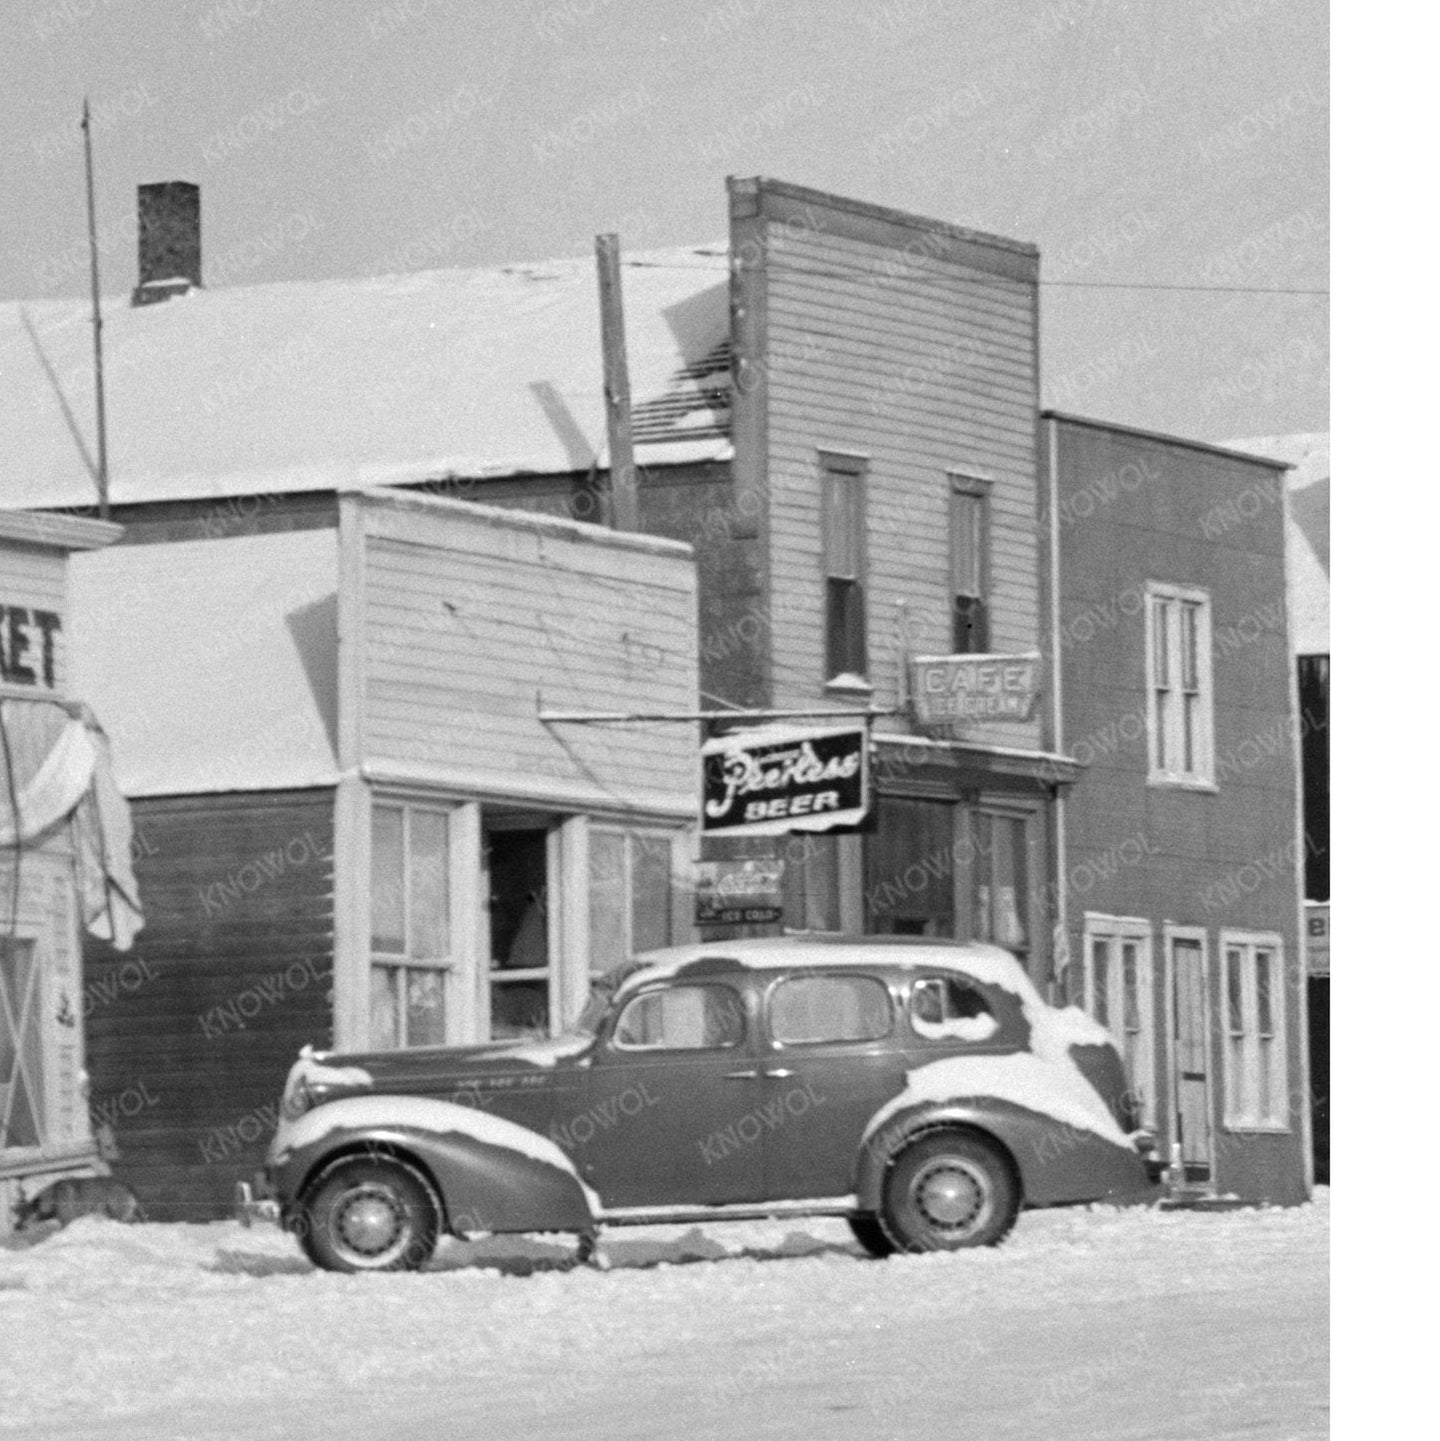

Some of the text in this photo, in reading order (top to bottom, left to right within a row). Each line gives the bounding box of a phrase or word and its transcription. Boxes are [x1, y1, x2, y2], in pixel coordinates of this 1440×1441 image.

[927, 666, 1024, 692] CAFE
[706, 741, 859, 818] Peerless
[744, 790, 840, 821] BEER
